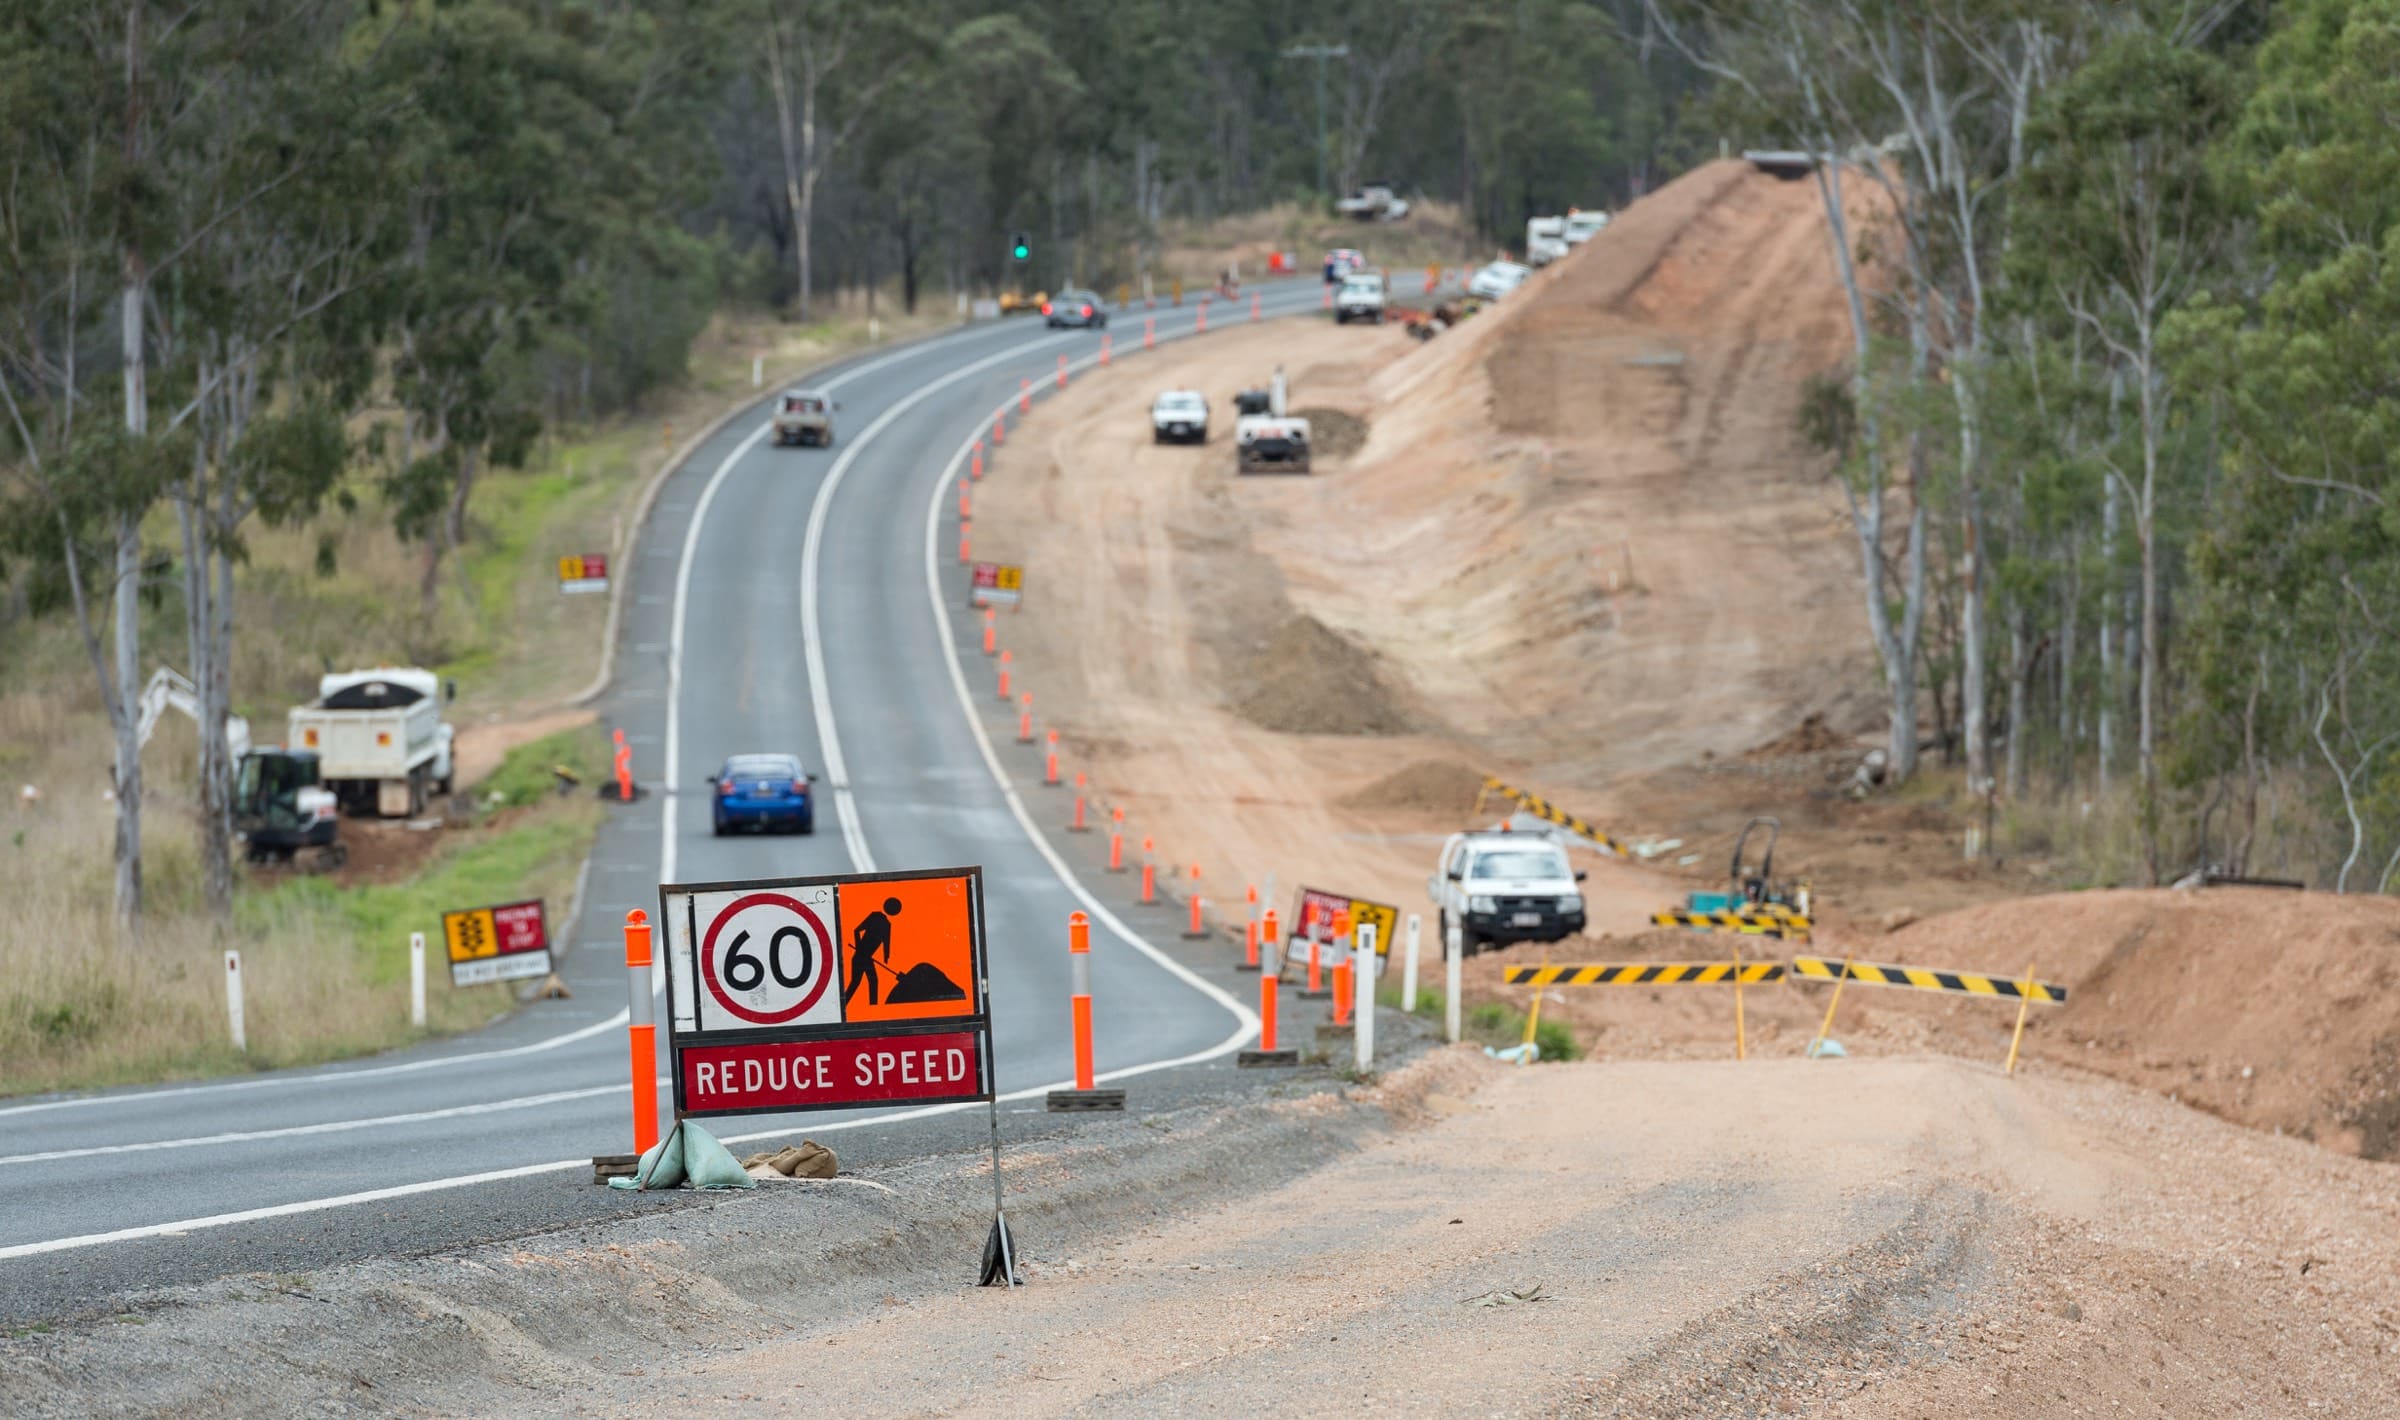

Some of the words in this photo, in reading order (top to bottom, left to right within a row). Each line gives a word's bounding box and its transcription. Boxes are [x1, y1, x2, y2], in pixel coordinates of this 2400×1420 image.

[724, 926, 812, 991] 60
[696, 1055, 834, 1095] REDUCE
[854, 1048, 966, 1087] SPEED
